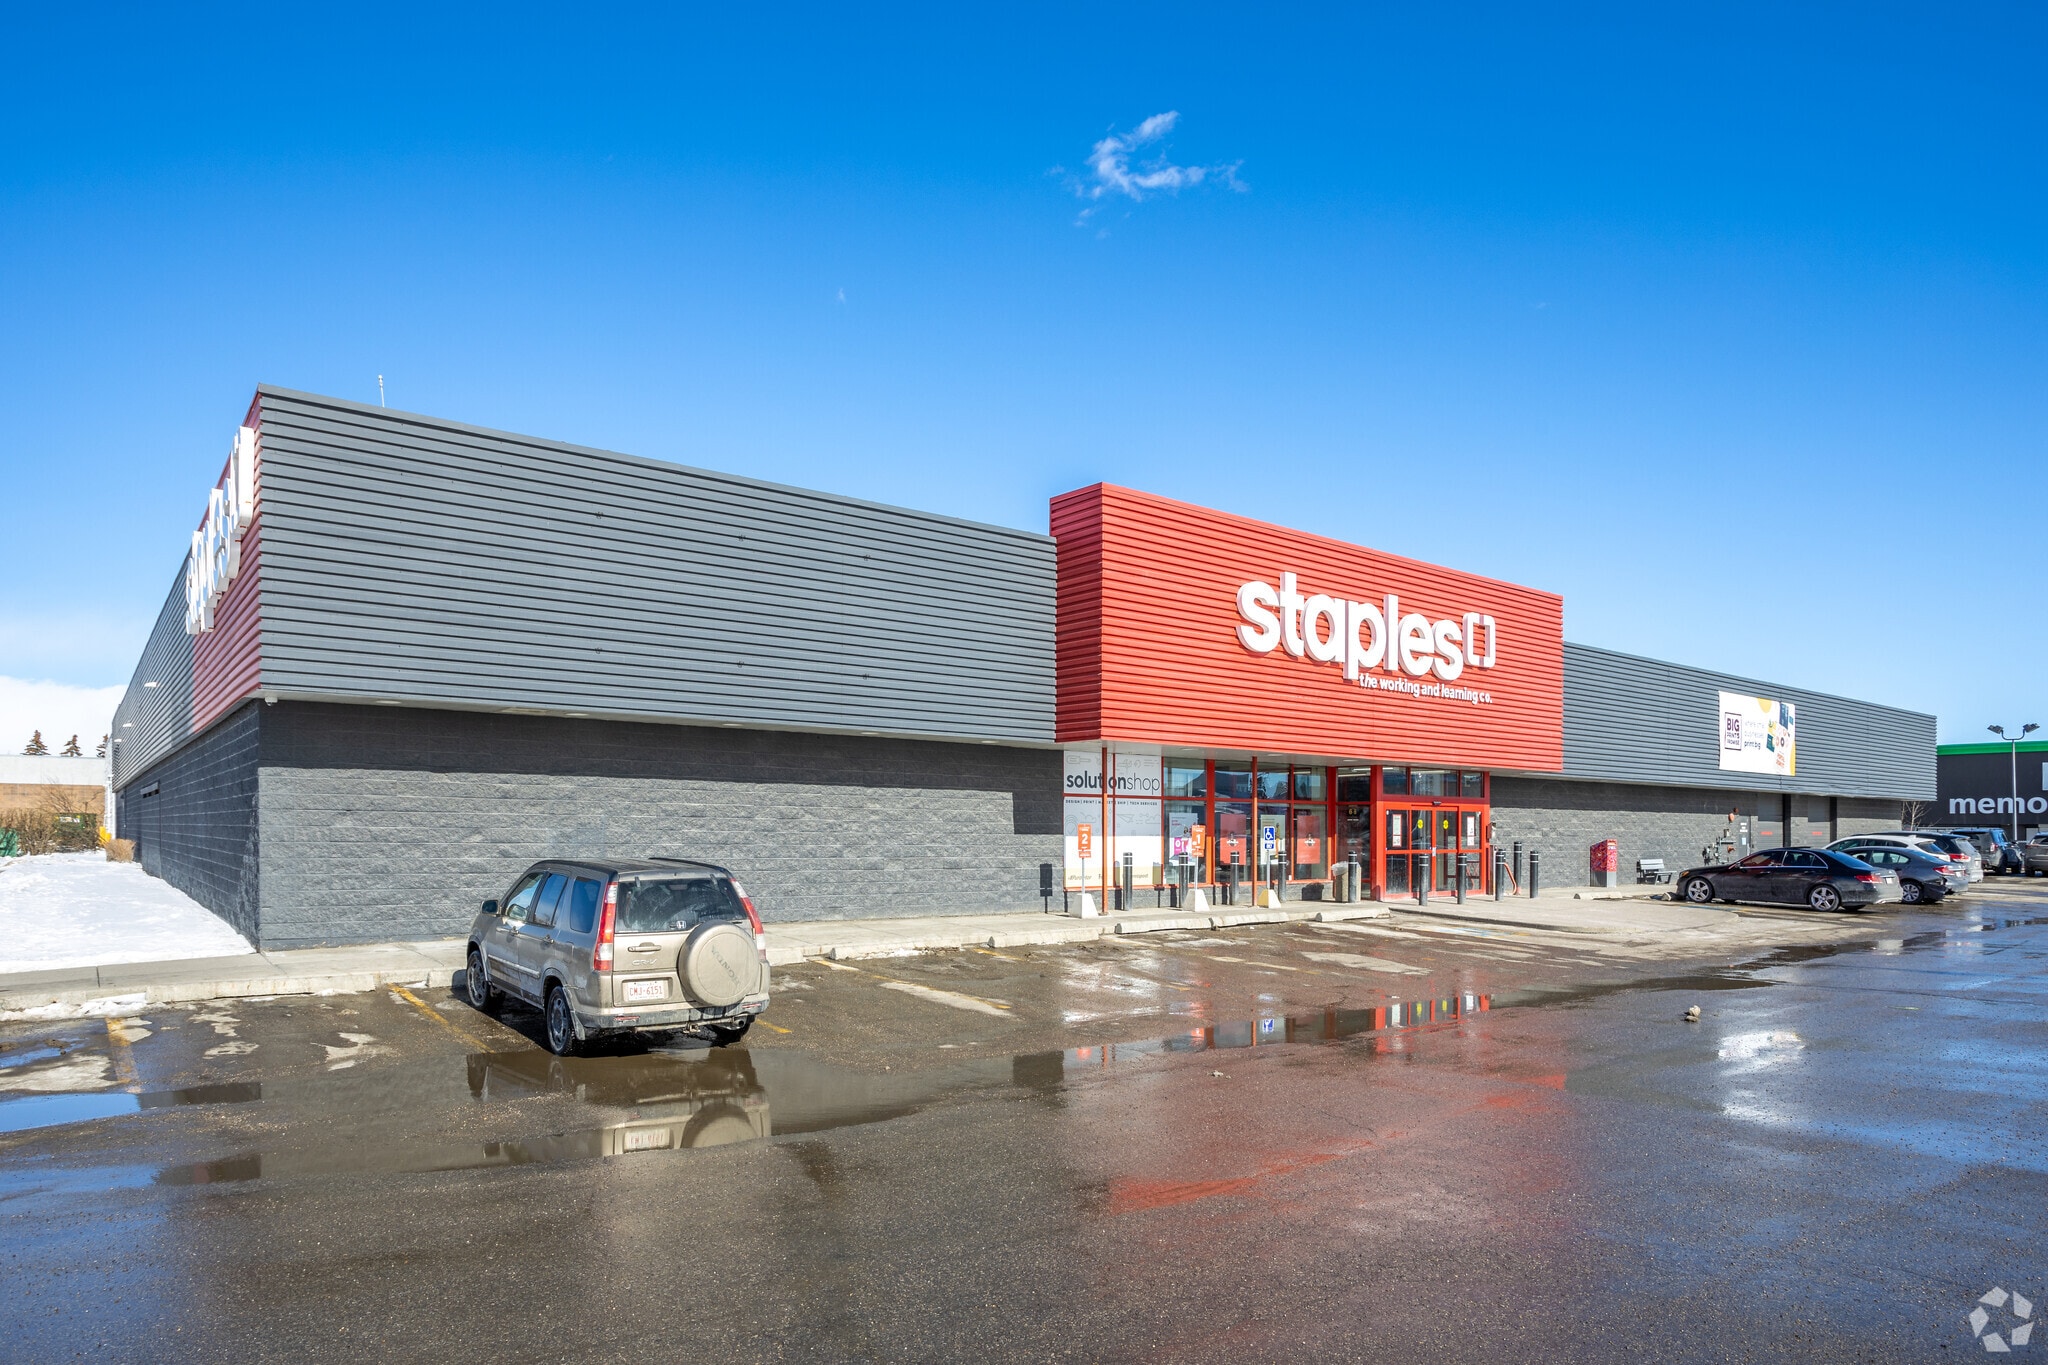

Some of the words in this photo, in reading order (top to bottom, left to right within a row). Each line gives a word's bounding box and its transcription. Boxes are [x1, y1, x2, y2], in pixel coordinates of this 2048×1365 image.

[1236, 571, 1464, 681] staples
[1359, 673, 1377, 688] the
[1380, 678, 1420, 698] working
[1421, 683, 1440, 697] and
[1441, 683, 1478, 704] learning
[1479, 693, 1493, 704] co.
[1726, 717, 1740, 732] BIG
[1066, 770, 1160, 795] solutonshop
[1081, 833, 1088, 844] 2
[630, 985, 662, 996] CMJ-6151
